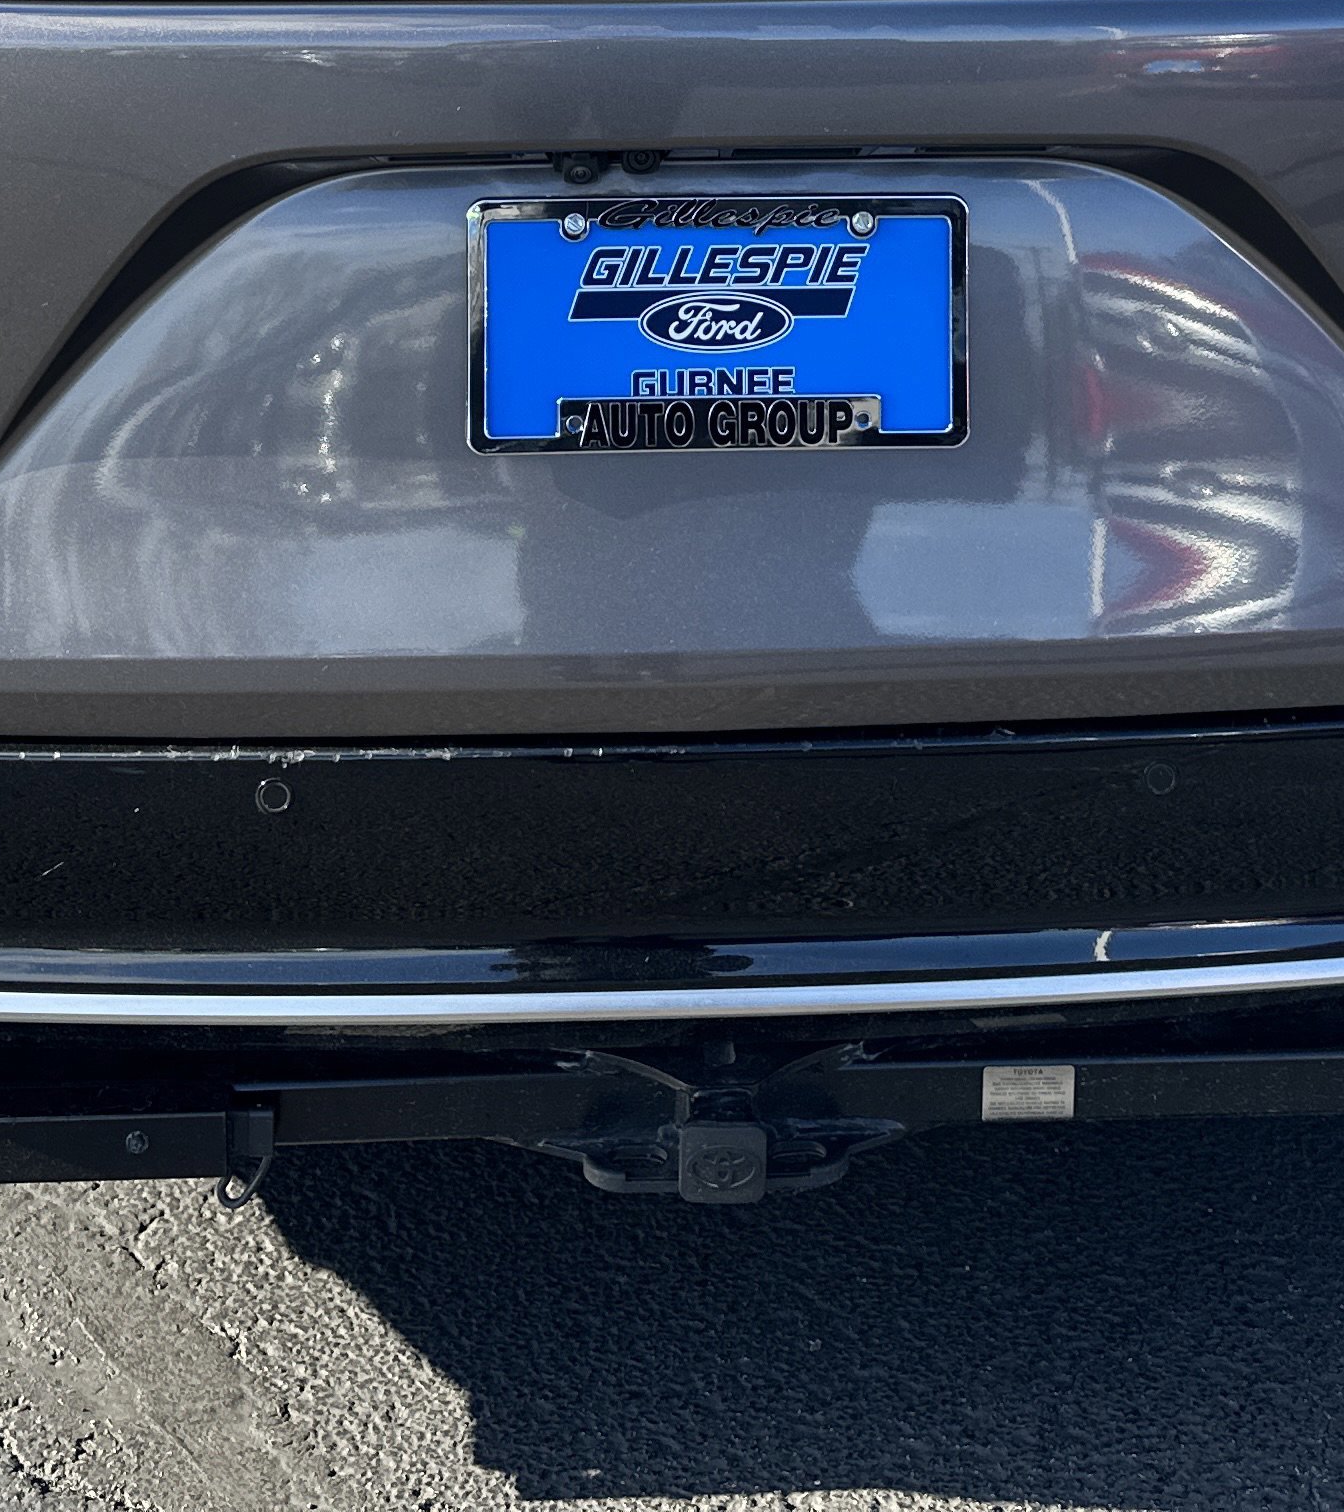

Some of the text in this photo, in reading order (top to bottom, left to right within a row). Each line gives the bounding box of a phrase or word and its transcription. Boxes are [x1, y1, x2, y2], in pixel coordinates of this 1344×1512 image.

[598, 198, 840, 235] Gillespie
[580, 244, 870, 288] GILLESPIE
[667, 302, 763, 343] Ford
[631, 367, 795, 396] GURNEE
[580, 399, 854, 448] AUTO GROUP
